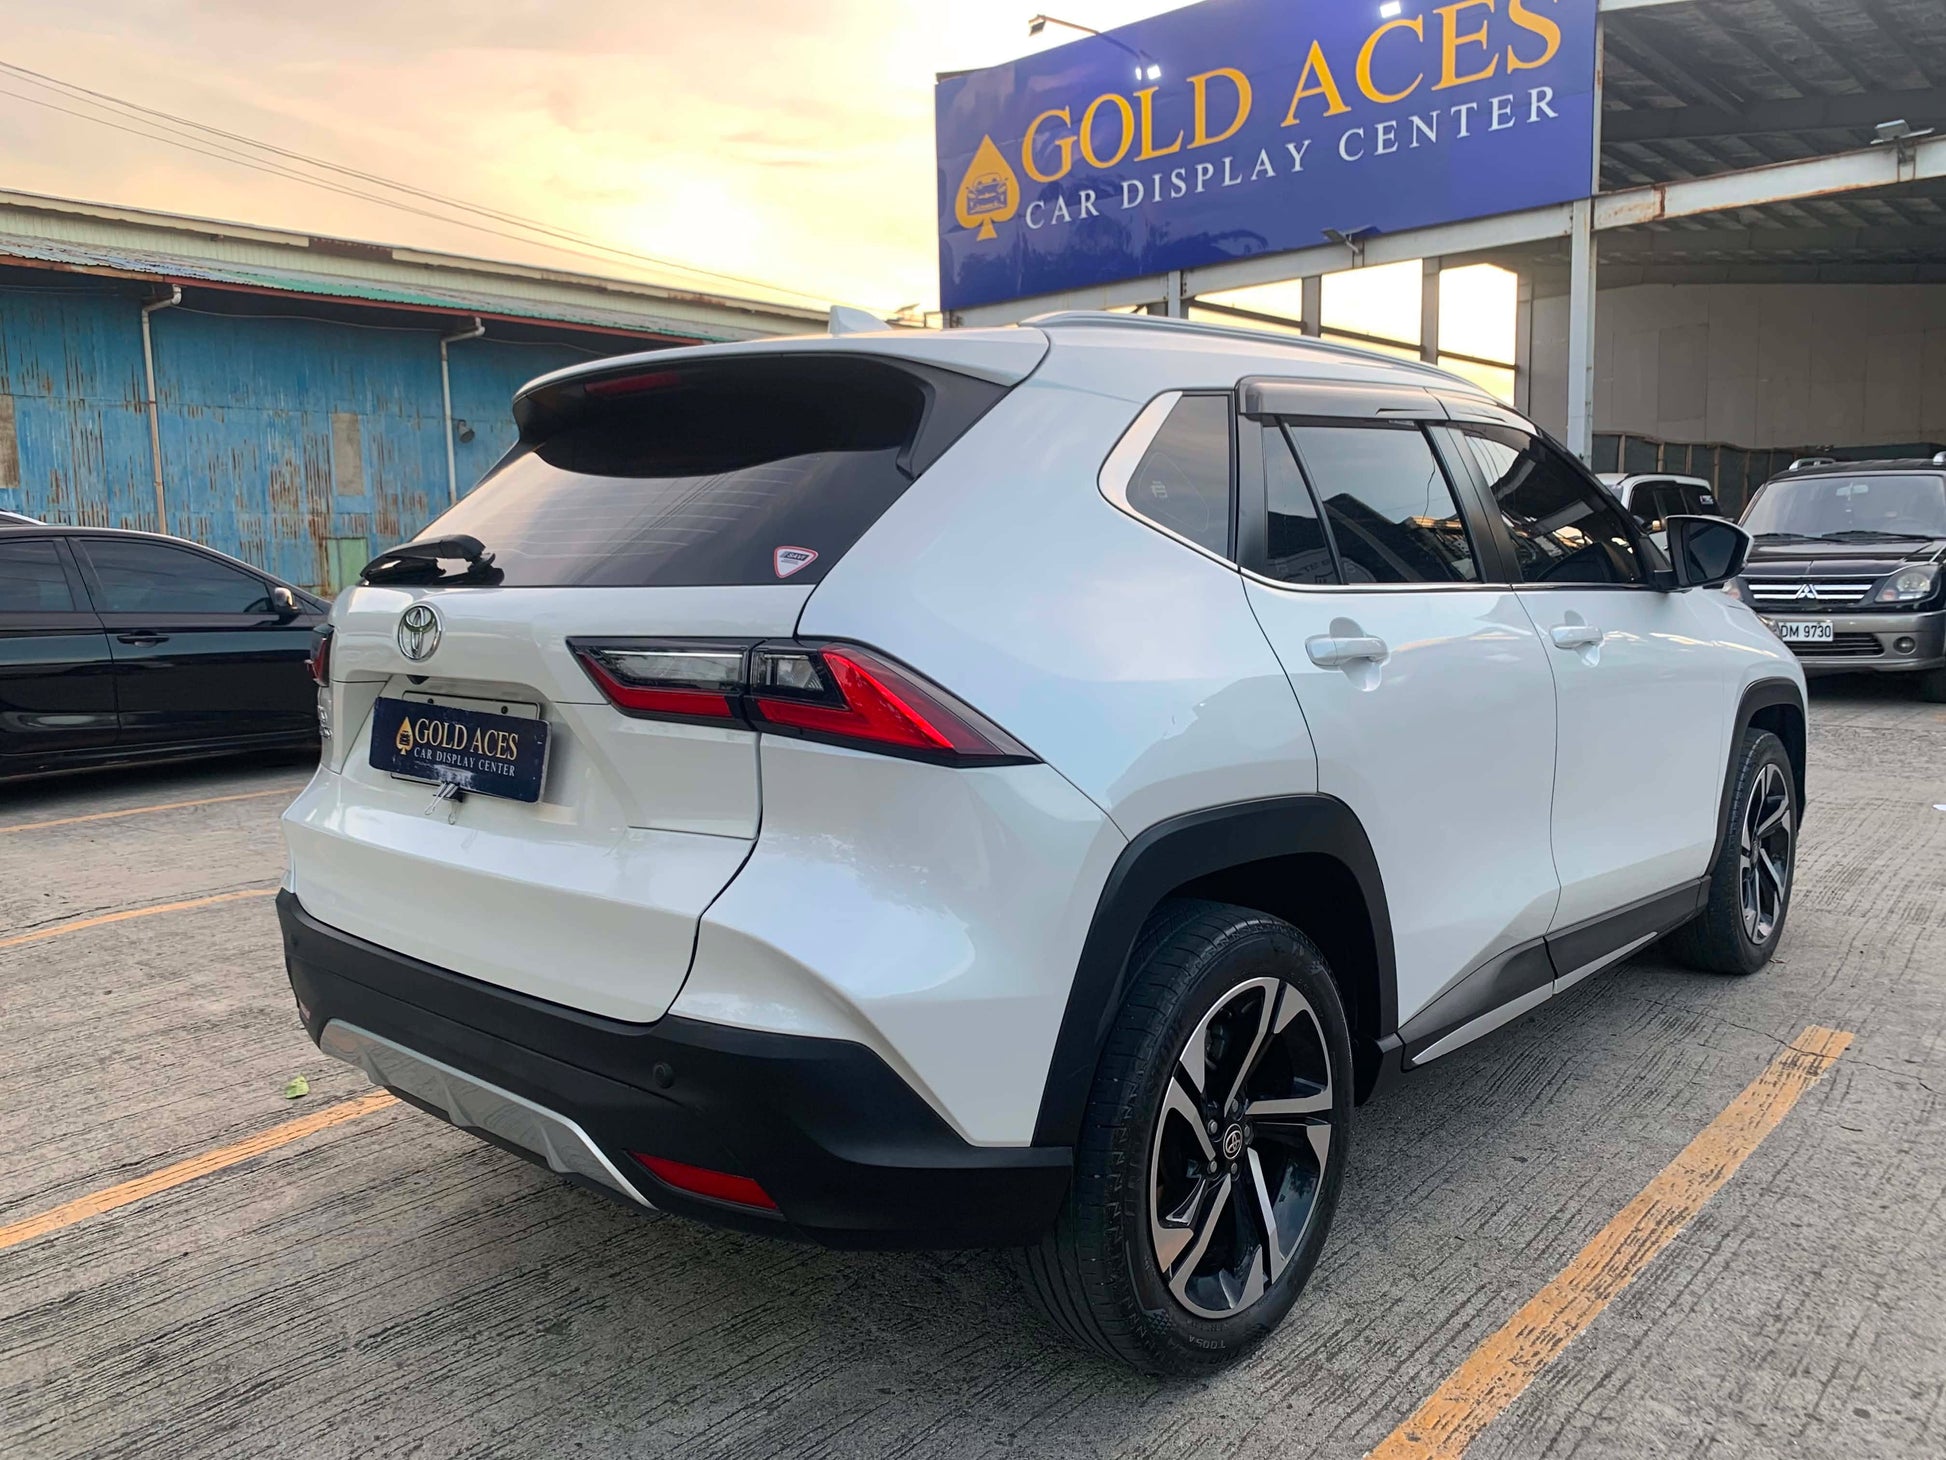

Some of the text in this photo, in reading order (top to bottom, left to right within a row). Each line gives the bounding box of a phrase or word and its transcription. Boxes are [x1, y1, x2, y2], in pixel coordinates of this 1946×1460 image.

[1021, 0, 1561, 183] GOLD ACES
[1025, 86, 1559, 229] CAR DISPLAY CENTER
[1803, 625, 1832, 638] 9730
[415, 718, 519, 760] GOLD ACES
[414, 746, 516, 777] CAR DISPLAY CENTER
